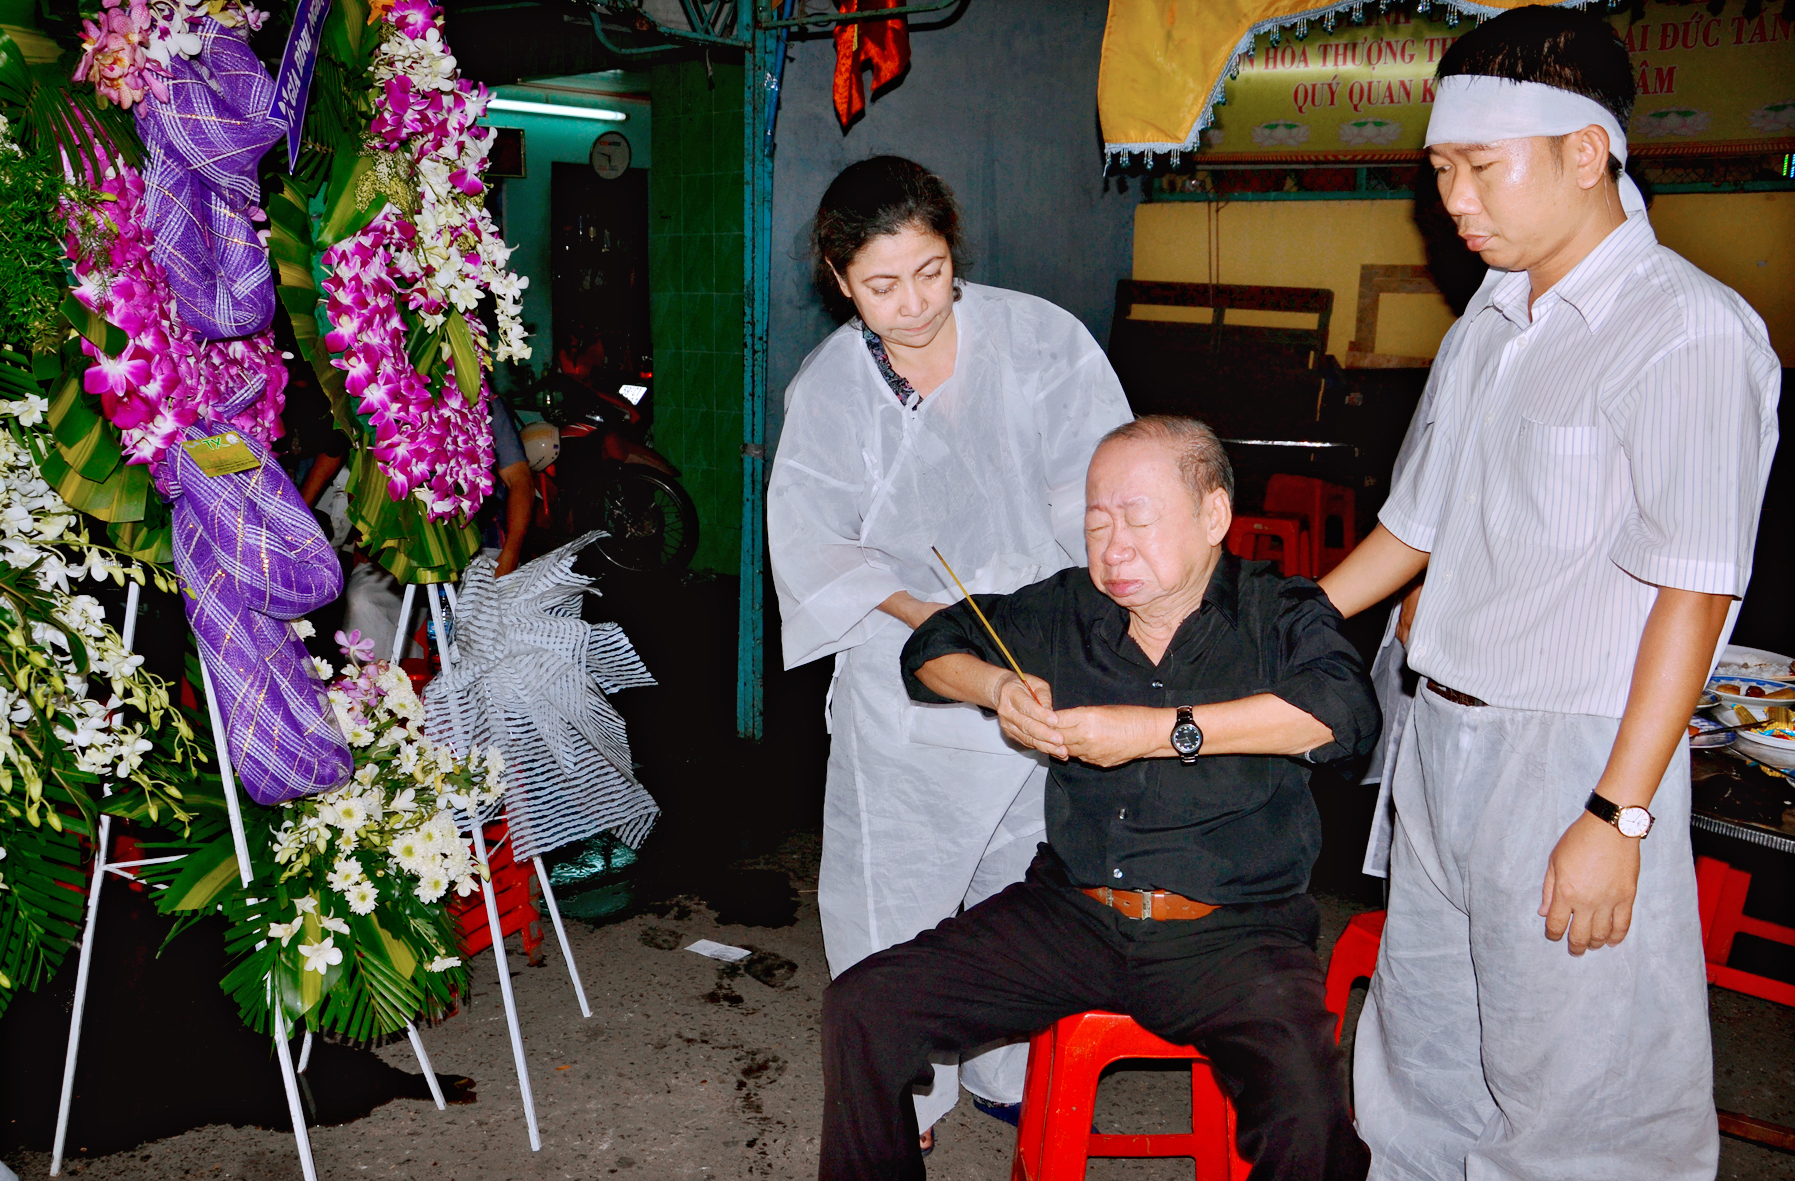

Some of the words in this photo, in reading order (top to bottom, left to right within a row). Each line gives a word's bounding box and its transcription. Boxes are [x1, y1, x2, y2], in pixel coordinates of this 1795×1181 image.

[1263, 38, 1310, 70] HÒA
[1318, 36, 1416, 70] THƯỢNG
[1658, 11, 1722, 50] ĐỨC
[1292, 75, 1342, 114] QUÝ
[1348, 78, 1414, 112] QUAN
